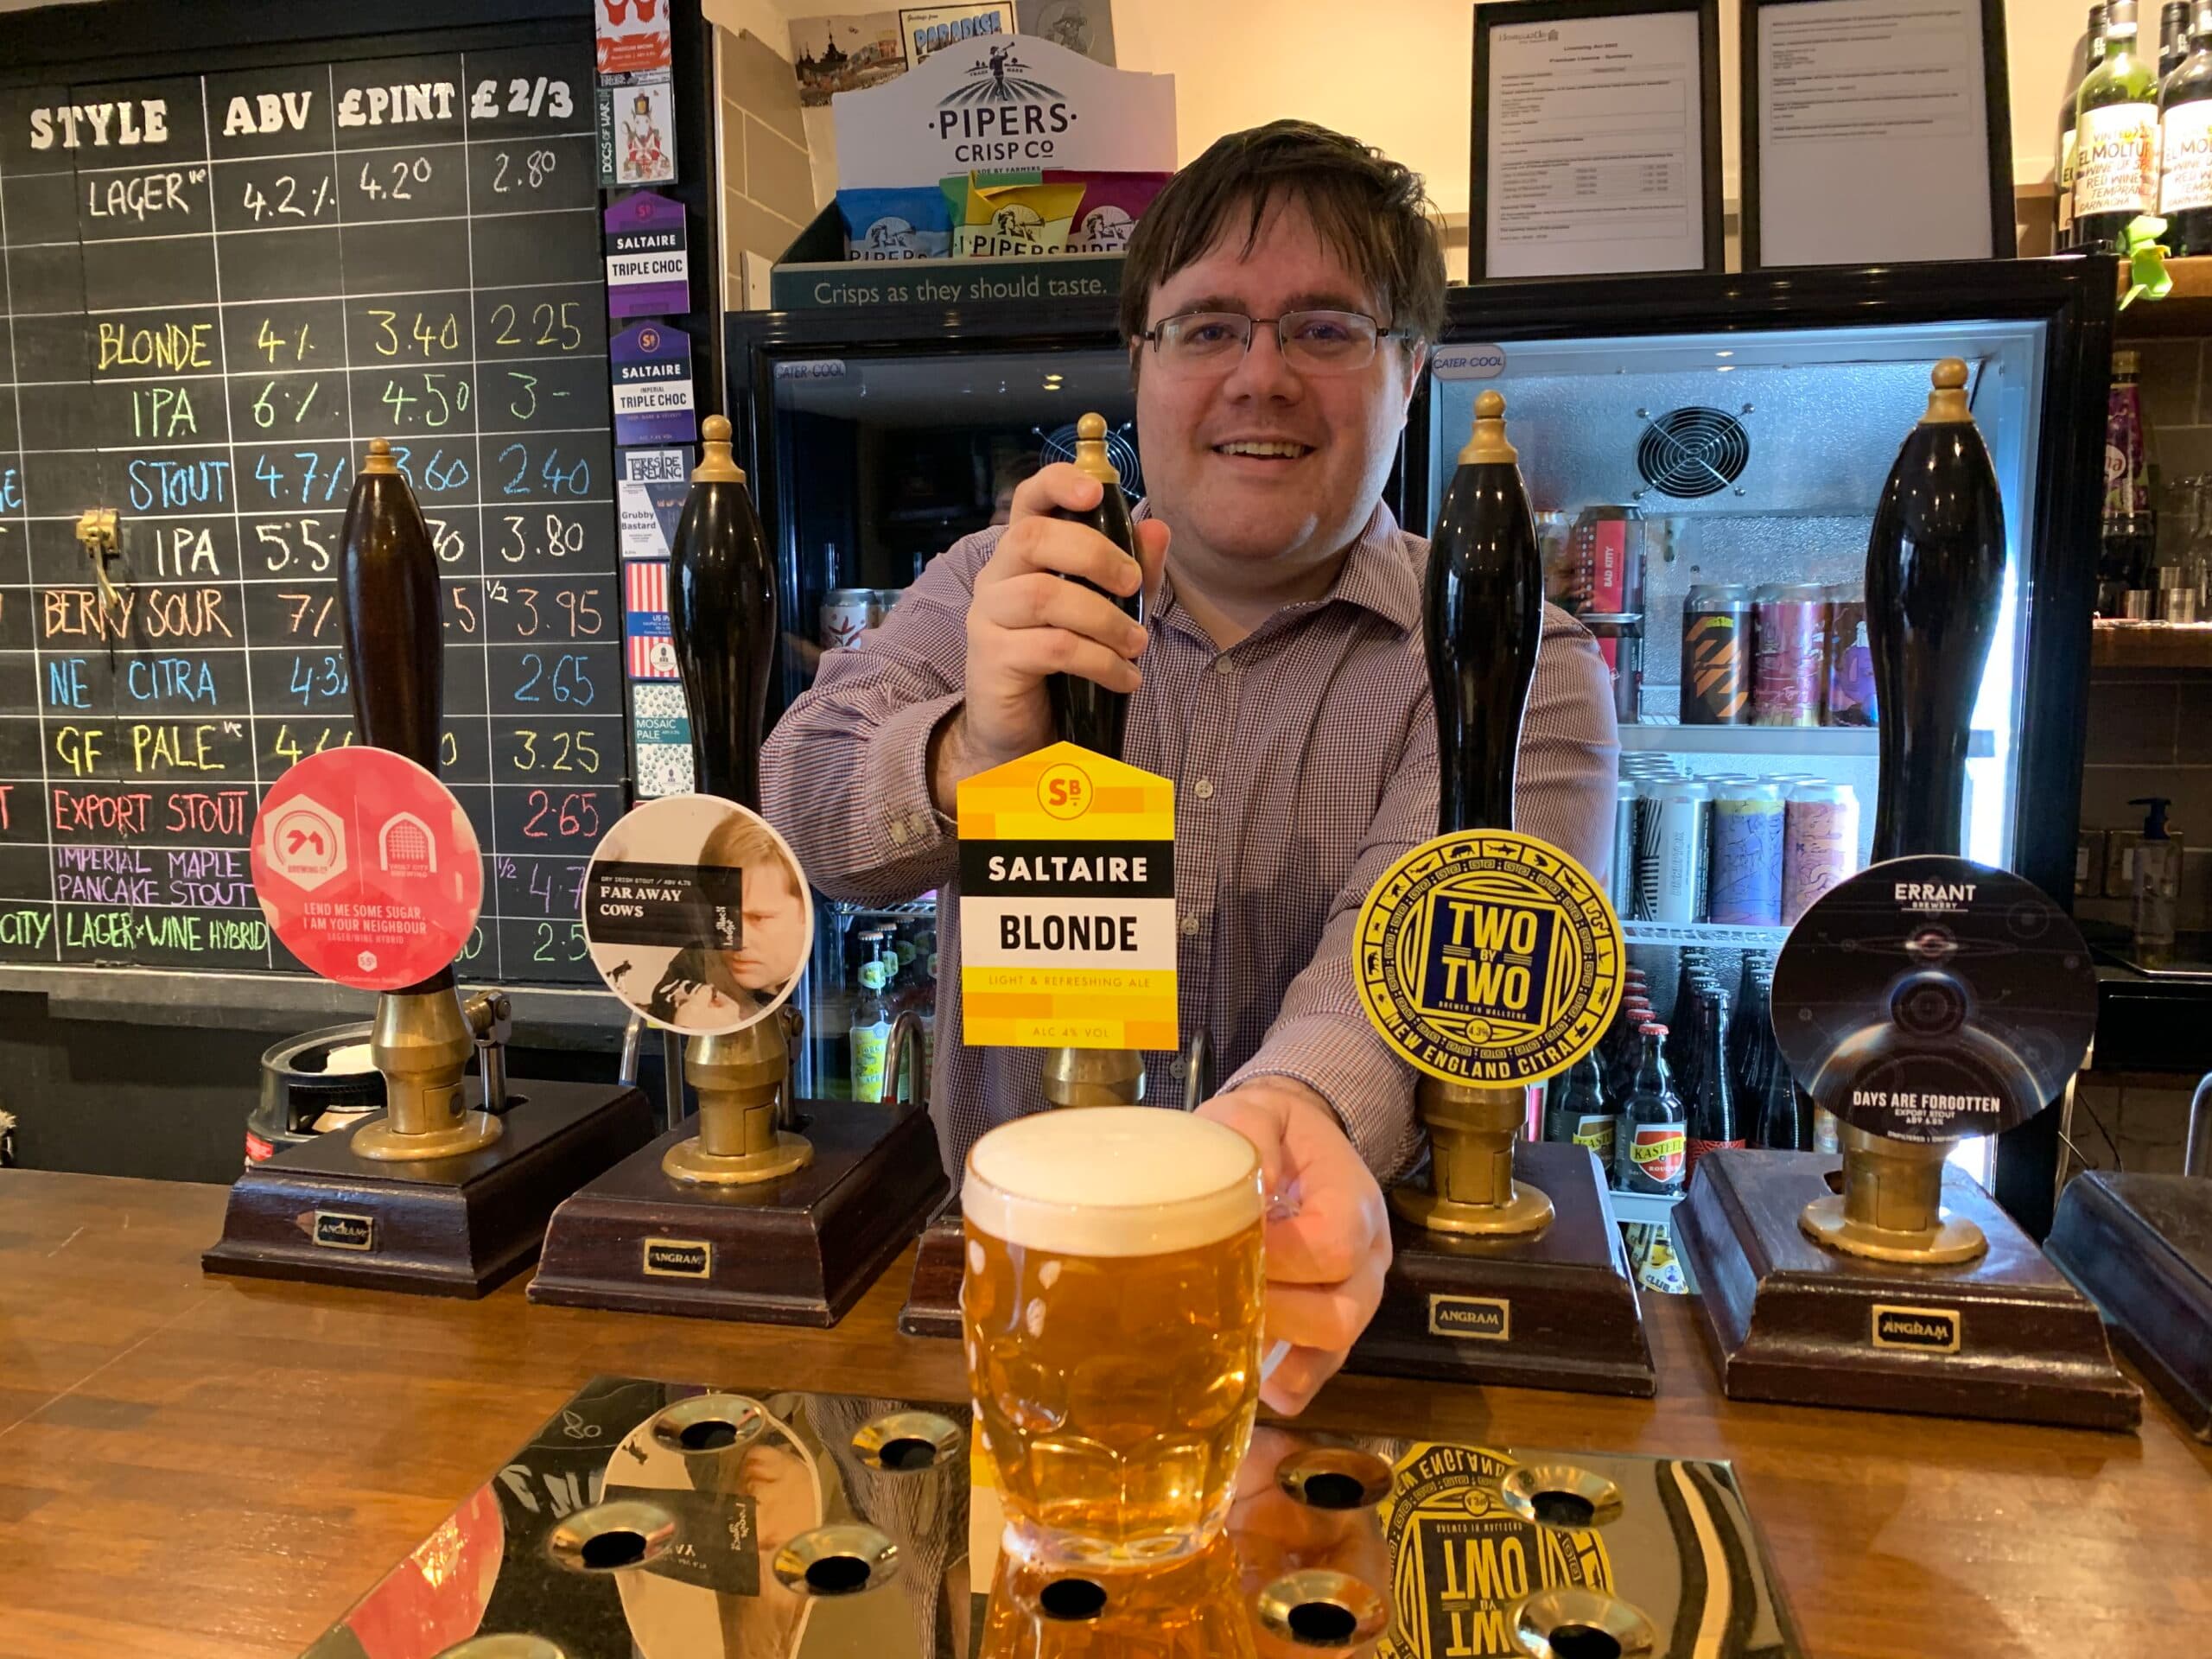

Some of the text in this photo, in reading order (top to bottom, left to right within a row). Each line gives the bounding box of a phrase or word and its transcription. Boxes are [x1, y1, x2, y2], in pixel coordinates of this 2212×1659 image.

[29, 99, 169, 149] STYLE
[223, 92, 312, 137] ABV
[337, 81, 455, 128] £PINT
[939, 103, 1069, 140] PIPERS
[955, 143, 1019, 162] CRISP
[617, 234, 677, 250] SALTAIRE
[613, 259, 683, 277] TRIPLE CHOC
[815, 276, 1108, 306] Crisps as they should taste.
[99, 322, 213, 372] BLONDE
[622, 363, 682, 379] SALTAIRE
[620, 393, 687, 409] TRIPLE CHOC
[133, 387, 198, 438] IPA
[129, 460, 230, 511] STOUT
[621, 511, 655, 520] Grubby
[621, 522, 657, 531] Bastard
[156, 527, 220, 577] IPA
[146, 588, 232, 638] SOUR
[50, 659, 92, 709] NE
[129, 658, 216, 705] CITRA
[636, 719, 677, 729] MOSAIC
[637, 729, 661, 740] PALE
[56, 727, 104, 775] GF
[134, 727, 226, 772] PALE
[55, 791, 151, 835] EXPORT
[166, 791, 249, 836] STOUT
[58, 847, 244, 880] IMPERIAL MAPLE
[988, 855, 1147, 883] SALTAIRE
[57, 874, 255, 908] PANCAKE STOUT
[601, 886, 683, 901] FAR AWAY
[1894, 882, 1977, 903] ERRANT
[303, 902, 332, 916] LEND
[334, 903, 351, 917] ME
[353, 905, 383, 918] SOME
[600, 904, 644, 918] COWS
[1912, 901, 1957, 910] BREWERY
[0, 912, 53, 952] CITY
[209, 912, 269, 953] HYBRID
[310, 918, 327, 931] AM
[329, 918, 359, 931] YOUR
[363, 920, 427, 934] NEIGHBOUR
[999, 914, 1139, 951] BLONDE
[1448, 901, 1539, 956] TWO
[1479, 948, 1497, 963] BY
[988, 975, 1151, 988] LIGHT & REFRESHING ALE
[1441, 956, 1531, 1011] TWO
[1438, 1001, 1470, 1012] BREWED
[1485, 1007, 1527, 1020] WALLSEND
[1033, 1026, 1056, 1037] ALC
[1084, 1027, 1109, 1039] VOL
[1384, 1012, 1575, 1080] NEW ENGLAND CITRA
[1853, 1090, 2000, 1113] DAYS ARE FORGOTTEN
[1895, 1109, 1955, 1119] EXPORT STOUT
[1440, 1309, 1499, 1325] ANGRAM
[1883, 1319, 1949, 1339] ANGRAM
